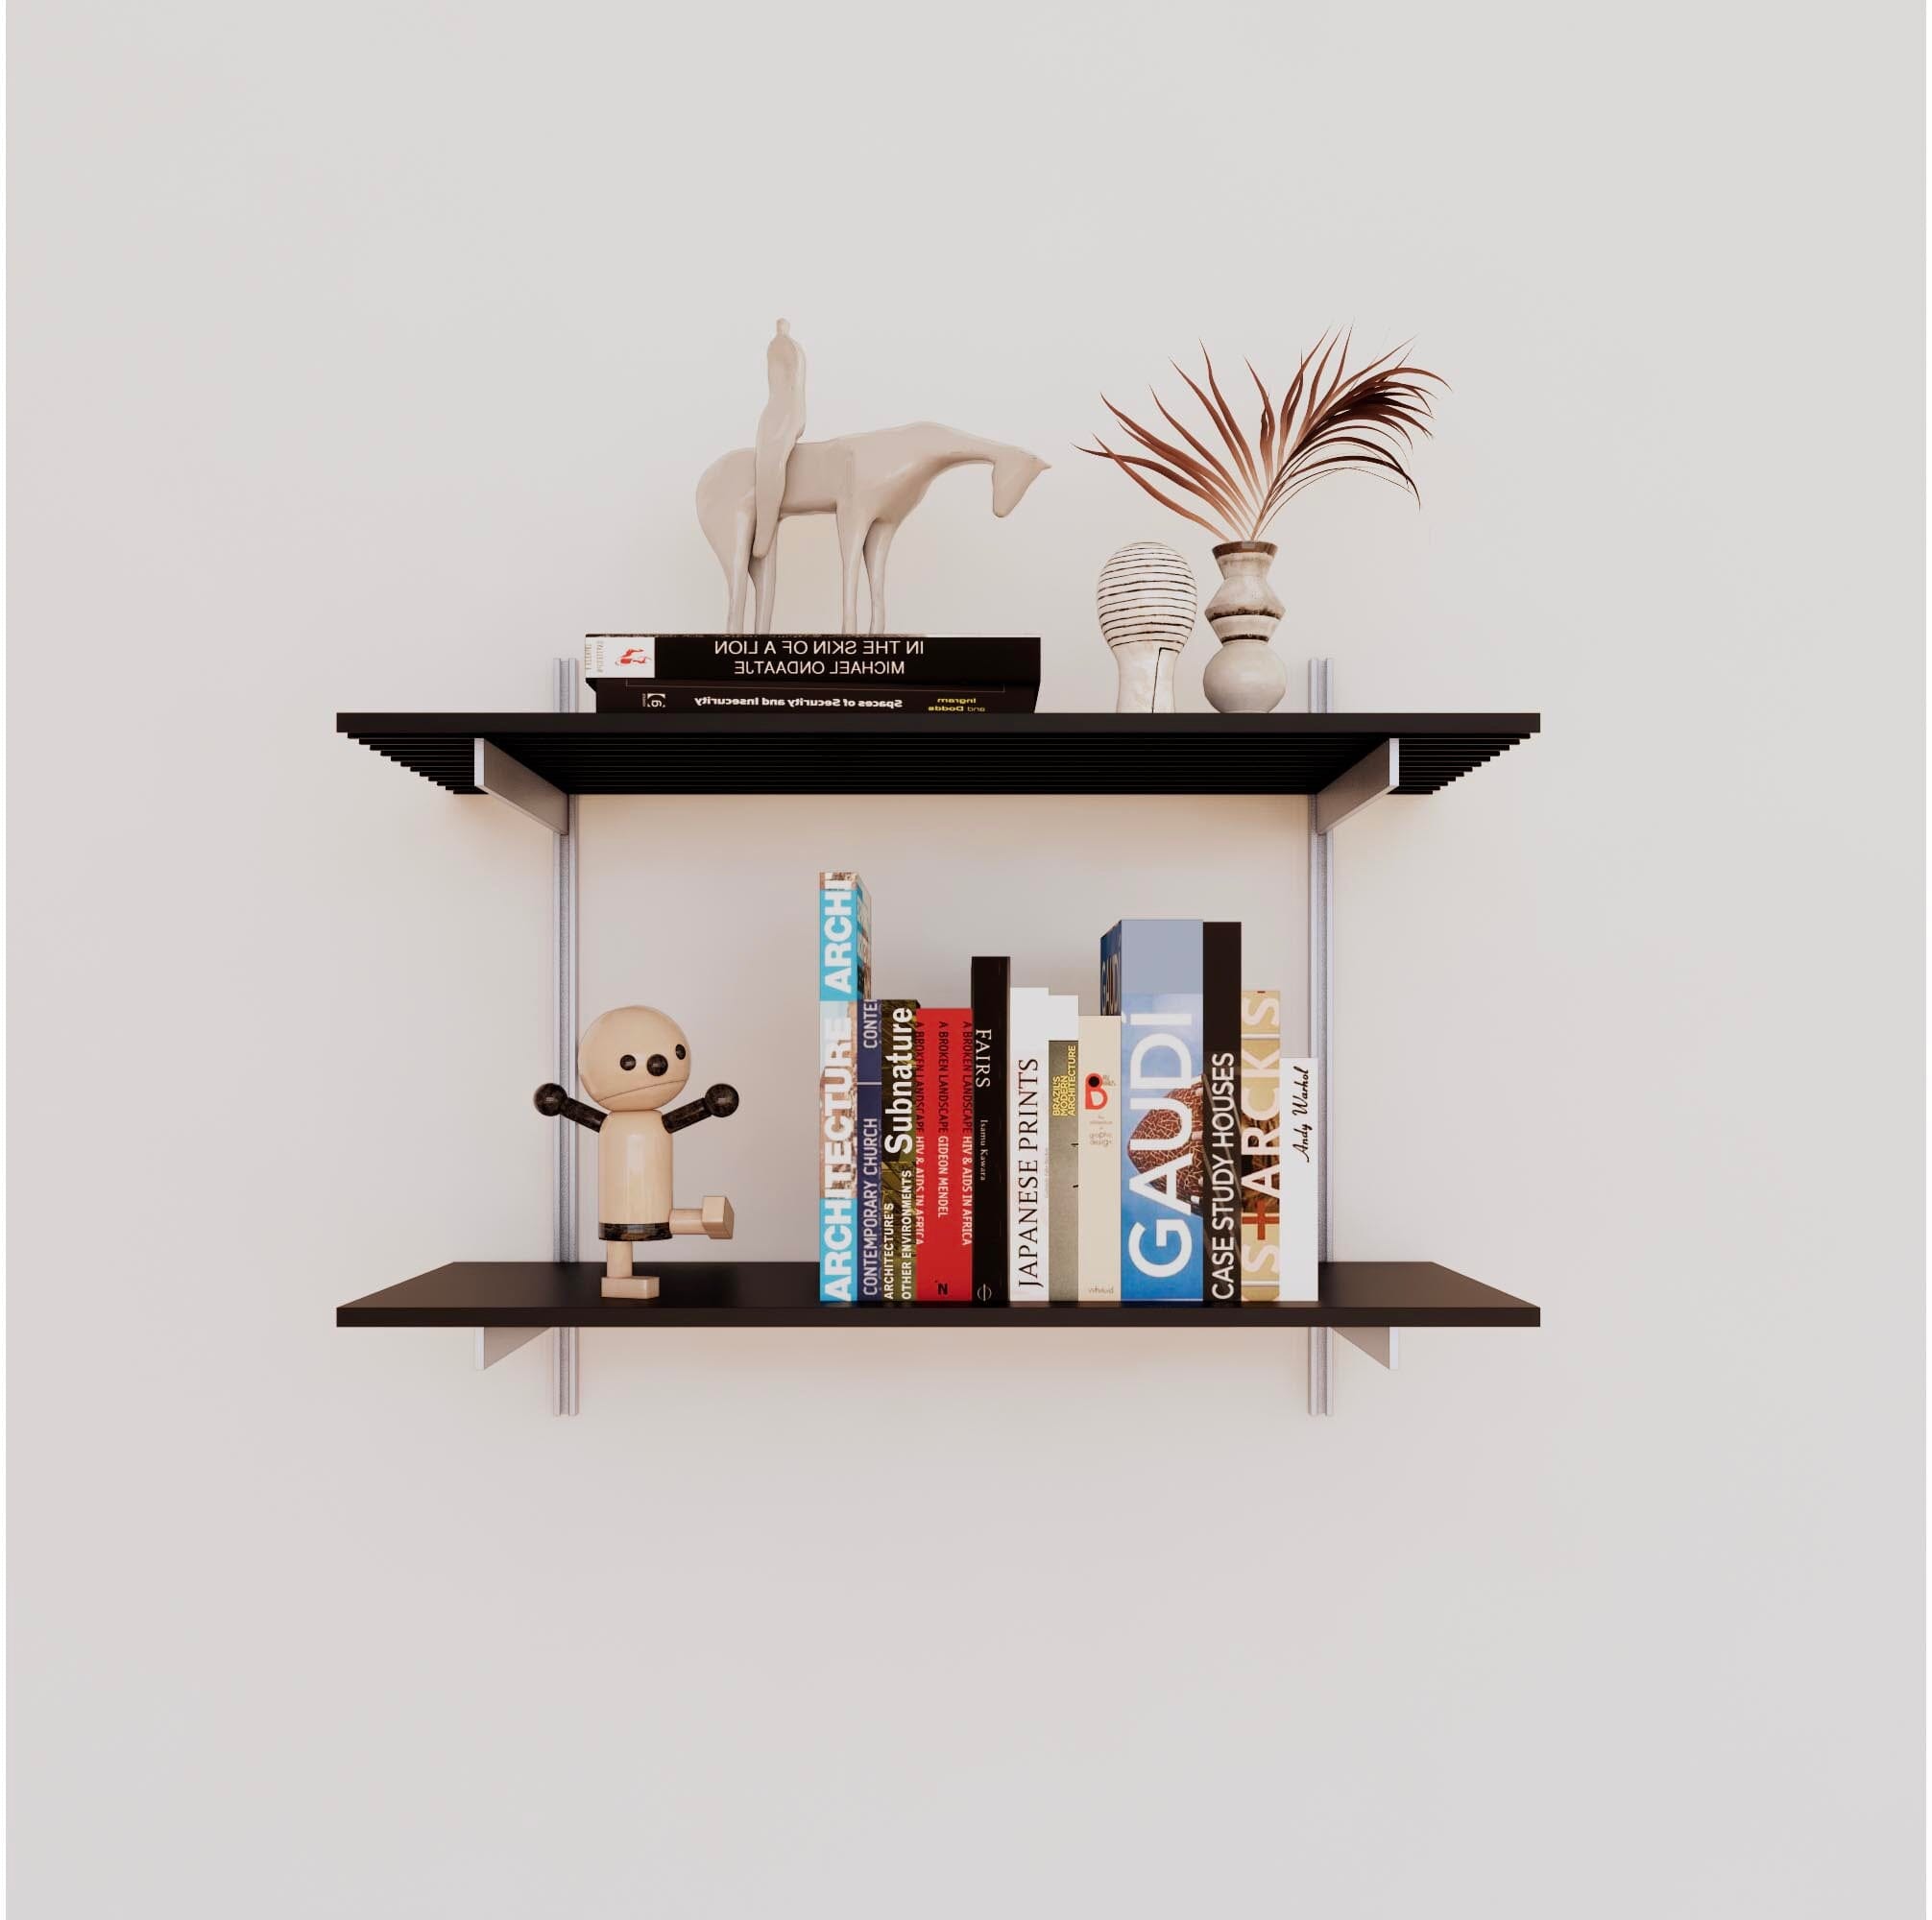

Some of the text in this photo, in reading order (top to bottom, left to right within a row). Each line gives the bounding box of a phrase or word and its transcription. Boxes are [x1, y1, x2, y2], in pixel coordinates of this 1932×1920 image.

[824, 873, 853, 995] ARCHI
[864, 999, 878, 1048] CONTE
[962, 1031, 973, 1072] BROKEN
[975, 1028, 992, 1089] FAIRS
[884, 1007, 913, 1155] Subnature
[938, 1020, 949, 1218] A BROKEN LANDSCAPE GIDEON MENDEL
[962, 1074, 973, 1134] LANDSCAPE
[1060, 1075, 1069, 1116] MODERN
[1068, 1044, 1076, 1116] ARCHITECTURE
[1292, 1065, 1313, 1164] Andy Warhol
[824, 1016, 853, 1303] ARCHITECTURE
[962, 1136, 973, 1155] HIV
[962, 1167, 973, 1192] AIDS
[980, 1148, 989, 1182] Kawara
[1018, 1059, 1044, 1287] JAPANESE PRINTS
[1212, 1052, 1235, 1299] CASE STUDY HOUSES
[863, 1118, 878, 1296] CONTEMPORARY CHURCH
[901, 1169, 912, 1300] OTHER ENVIRONMENTS
[962, 1210, 973, 1245] AFRICA
[883, 1202, 895, 1300] ARCHITECTURE'S
